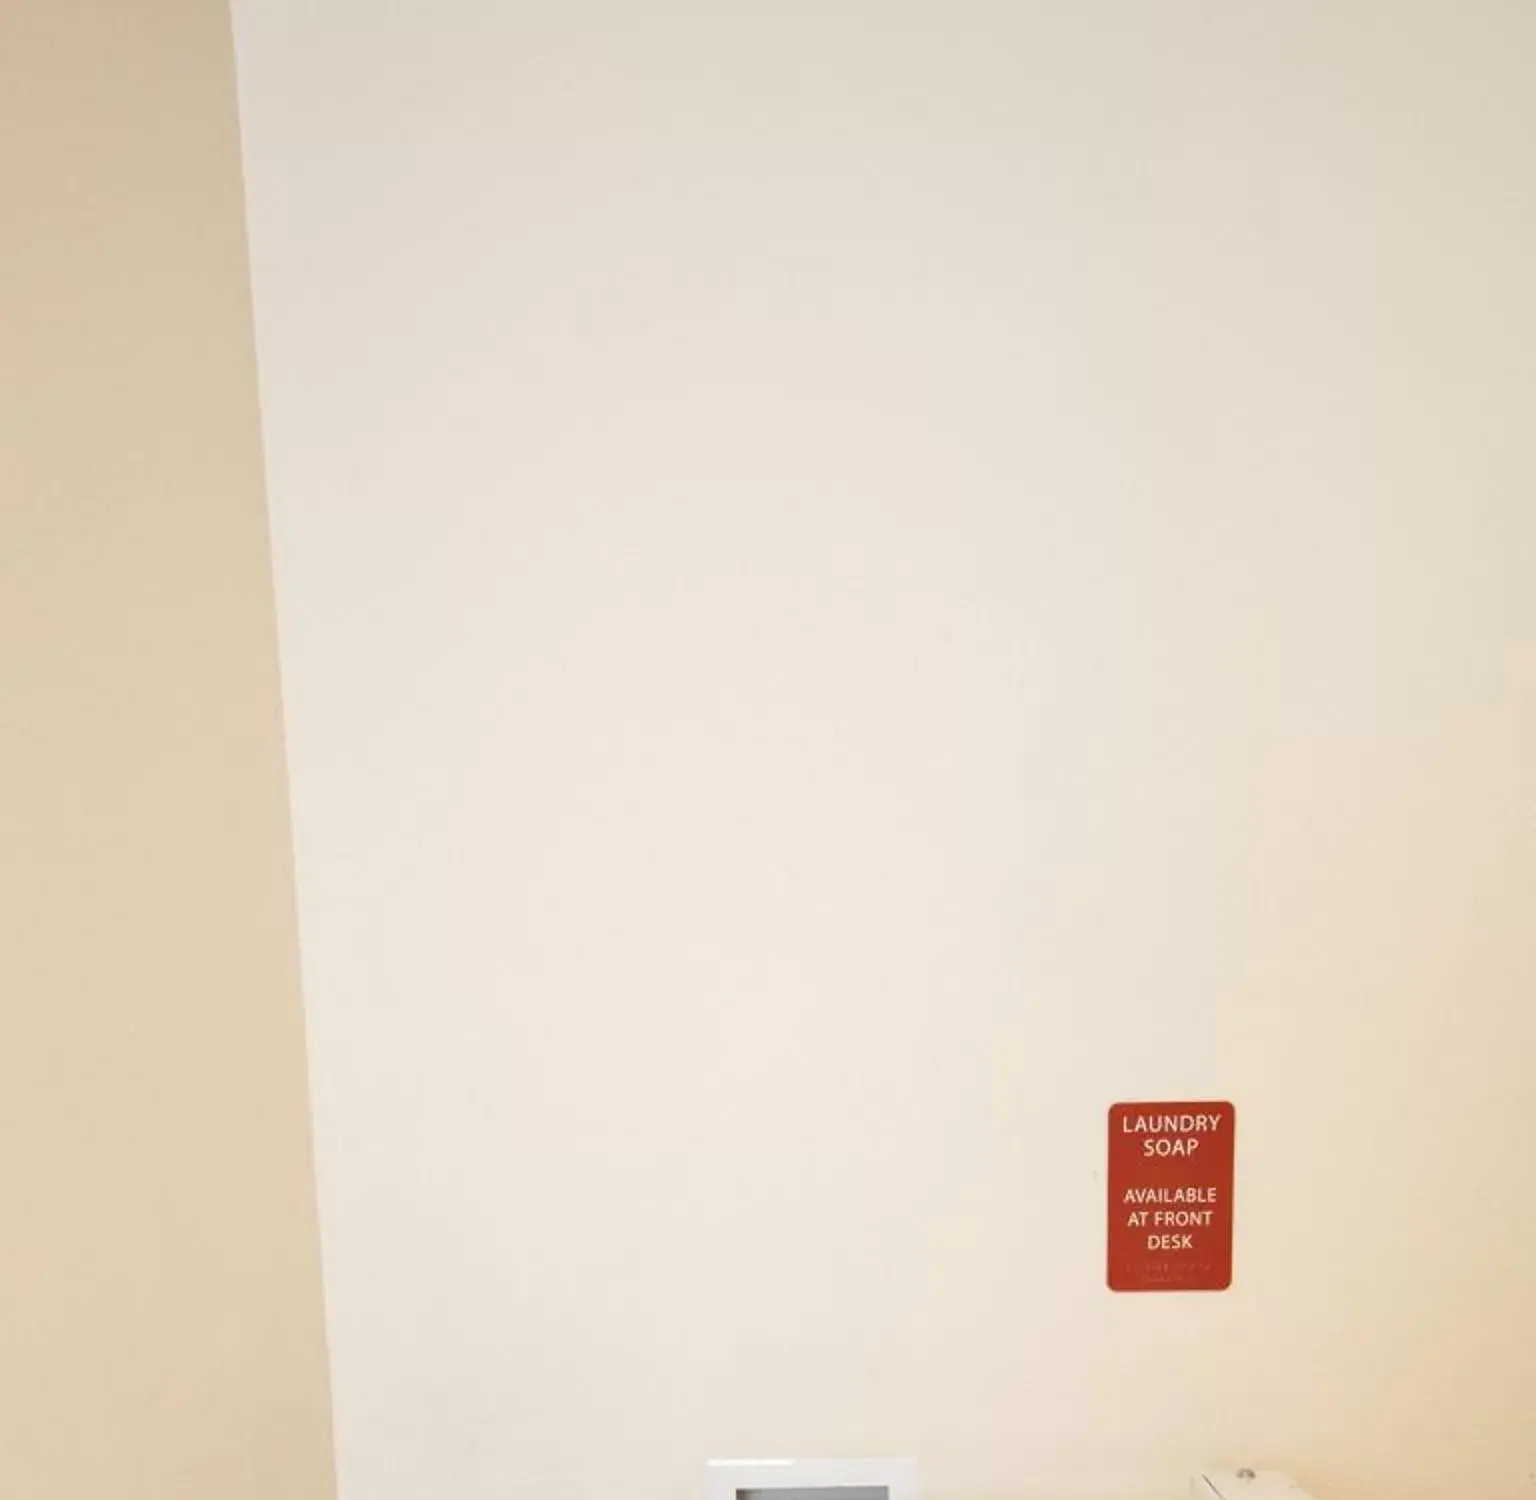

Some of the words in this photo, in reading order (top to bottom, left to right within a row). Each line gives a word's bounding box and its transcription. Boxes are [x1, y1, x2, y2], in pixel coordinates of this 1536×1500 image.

[1122, 1114, 1222, 1133] LAUNDRY
[1143, 1139, 1200, 1157] SOAP
[1123, 1187, 1217, 1204] AVAILABLE
[1127, 1211, 1149, 1227] AT
[1154, 1211, 1214, 1227] FRONT
[1147, 1234, 1193, 1250] DESK
